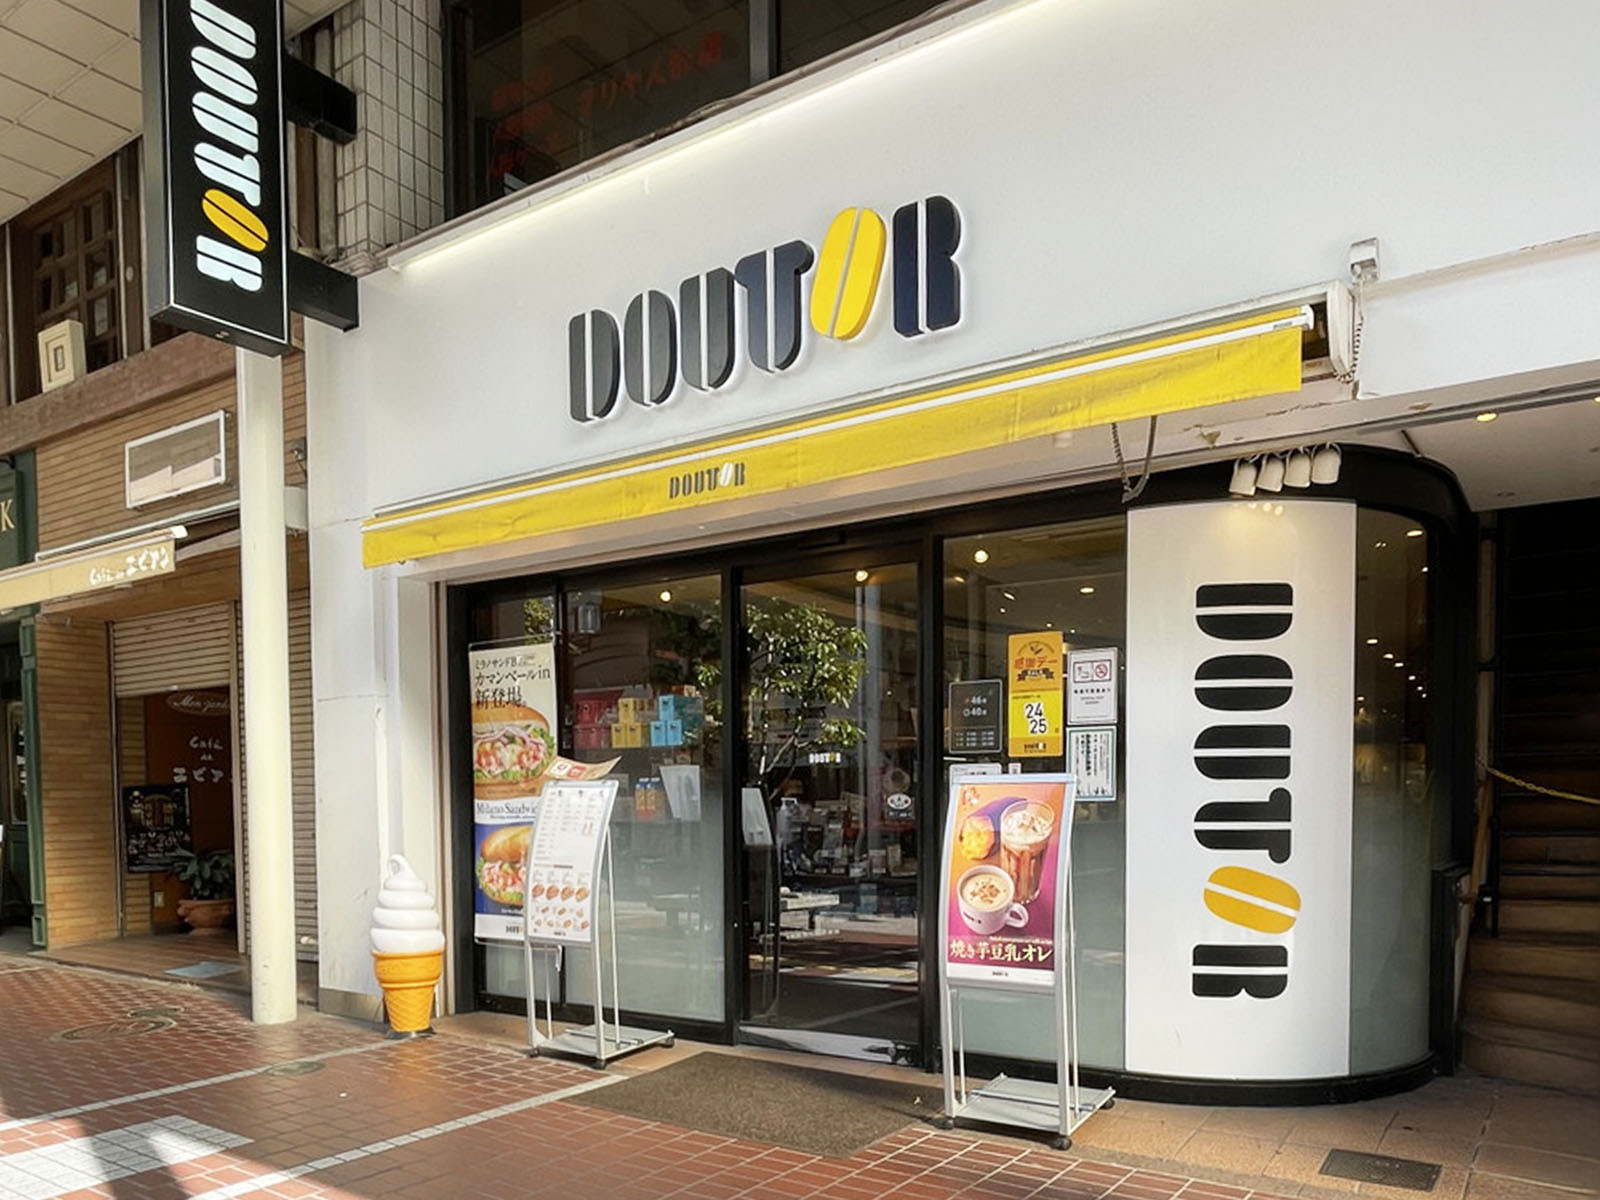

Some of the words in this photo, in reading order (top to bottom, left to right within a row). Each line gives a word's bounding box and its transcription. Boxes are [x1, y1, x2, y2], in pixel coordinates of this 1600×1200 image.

[190, 0, 269, 291] DOUTOR
[569, 195, 962, 423] DOUTOR
[668, 462, 745, 499] DOUTOR
[1025, 703, 1044, 720] 24
[1030, 718, 1048, 735] 25
[1192, 582, 1301, 999] DOUTOR
[949, 938, 1053, 963] 焼き芋豆乳オレ
